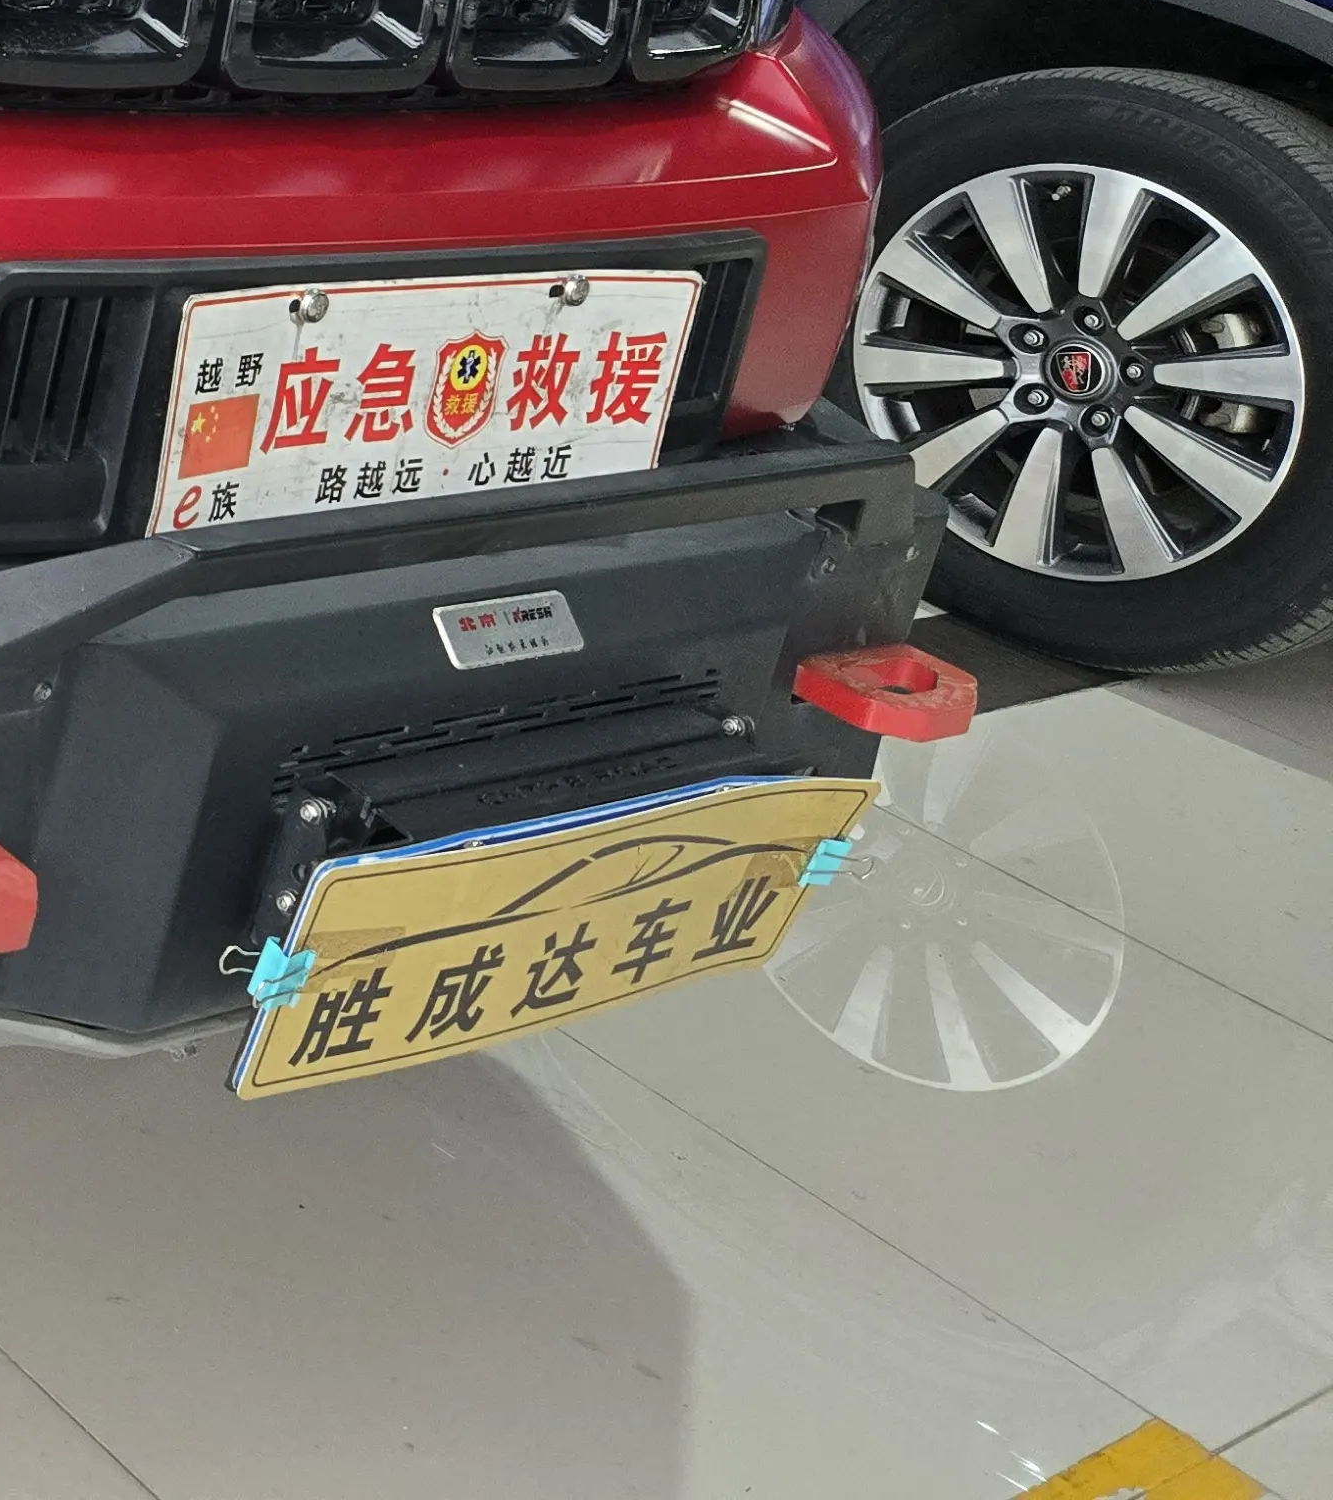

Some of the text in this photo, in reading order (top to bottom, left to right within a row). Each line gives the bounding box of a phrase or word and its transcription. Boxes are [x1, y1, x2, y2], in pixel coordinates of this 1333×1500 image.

[194, 350, 265, 396] 越野
[261, 330, 669, 455] 应急 救援
[444, 392, 479, 416] 救援
[459, 612, 497, 632] 北京
[288, 874, 779, 1068] 胜成达车业
